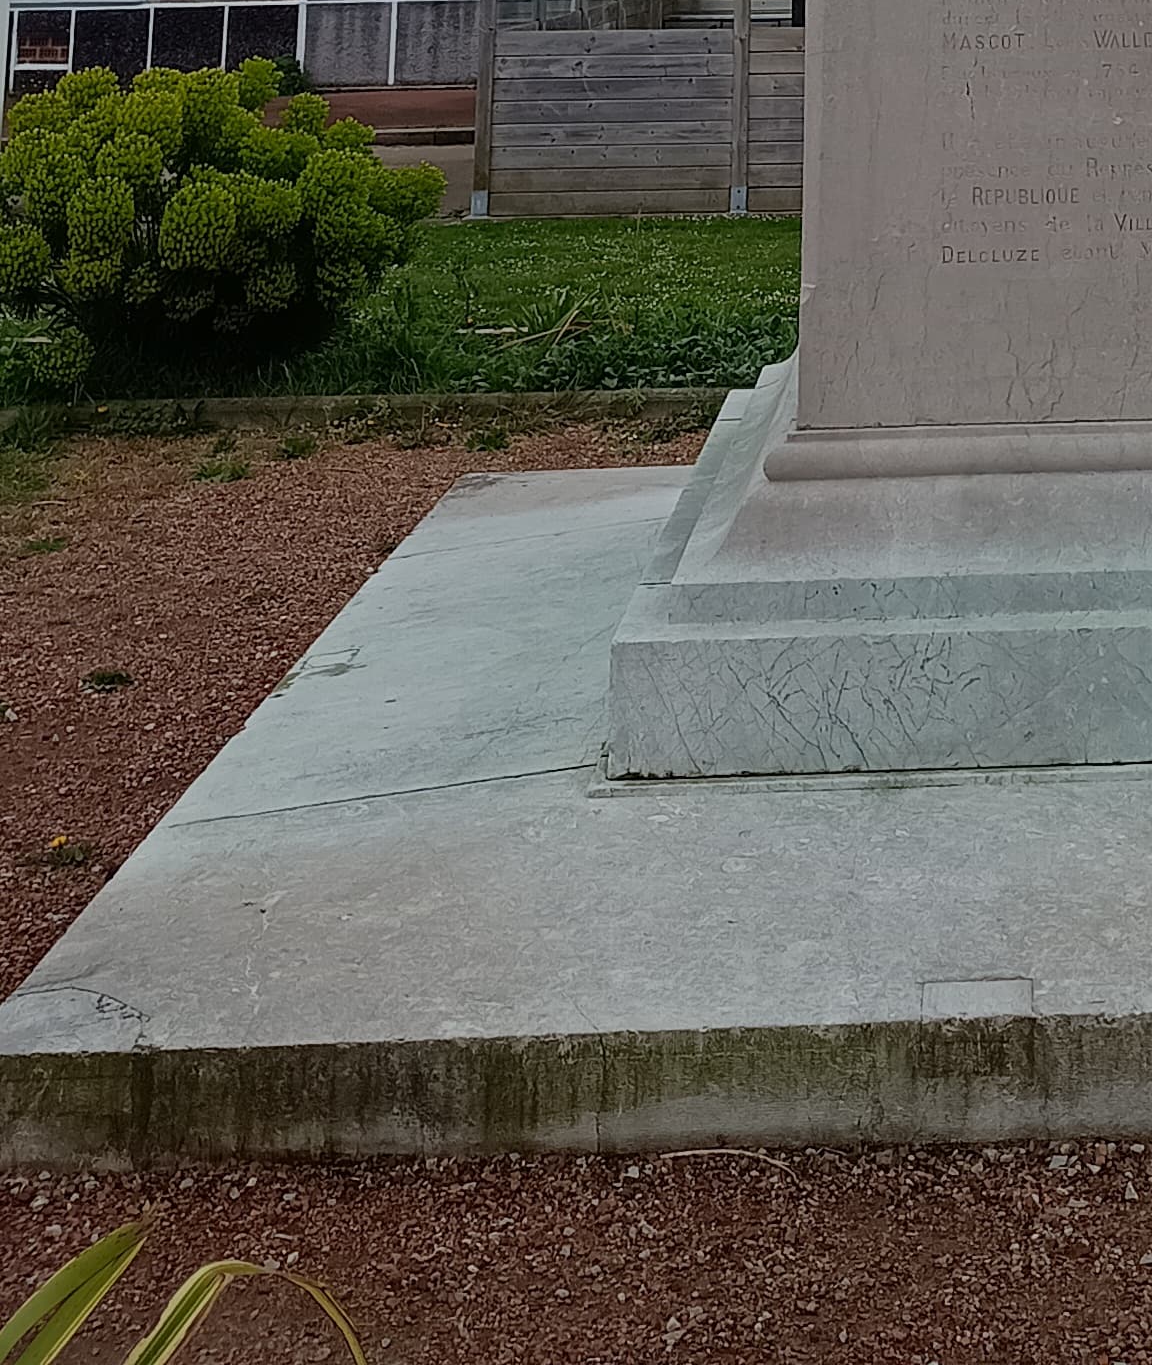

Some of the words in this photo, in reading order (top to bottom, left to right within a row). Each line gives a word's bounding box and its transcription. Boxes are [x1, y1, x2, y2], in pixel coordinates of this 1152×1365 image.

[943, 32, 1025, 51] MASCOT
[972, 186, 1080, 206] REPUBLIQUE
[941, 245, 1040, 264] DELCLUZE
